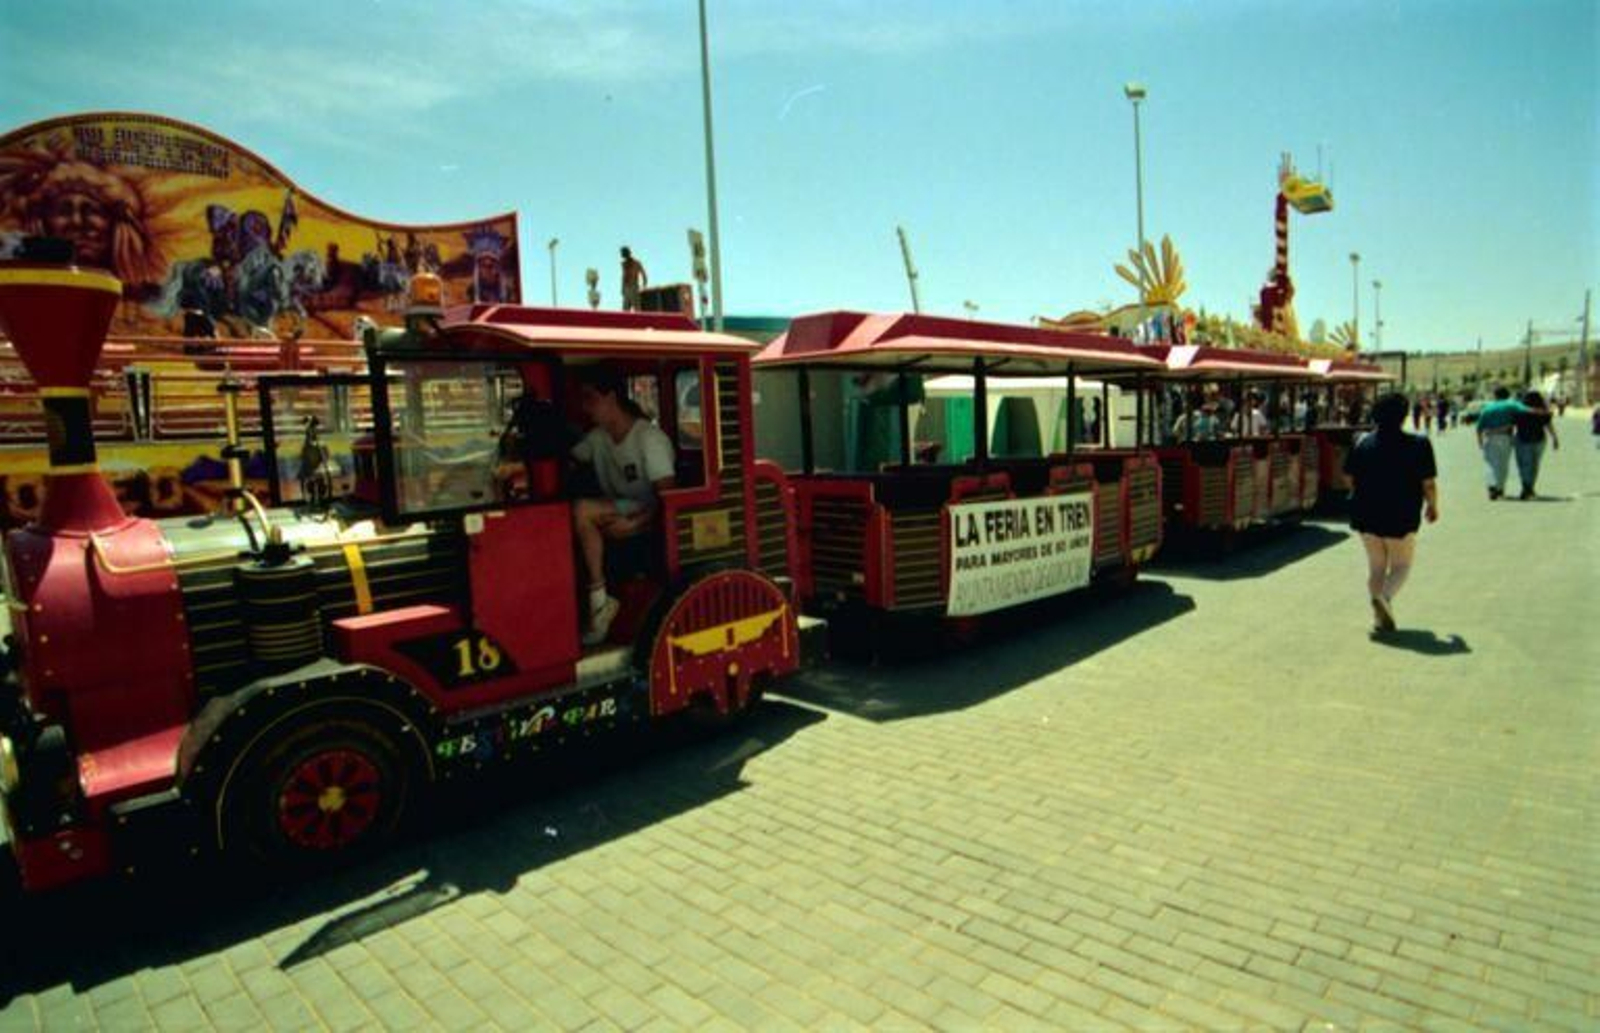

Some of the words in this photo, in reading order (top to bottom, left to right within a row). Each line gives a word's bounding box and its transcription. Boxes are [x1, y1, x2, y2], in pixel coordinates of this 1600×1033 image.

[955, 512, 980, 548] LA
[984, 507, 1030, 544] FERIA
[1035, 504, 1054, 536] EN
[1058, 501, 1089, 533] TREN
[956, 553, 987, 572] PARA
[991, 545, 1037, 567] MAYORES
[1040, 541, 1052, 558] DE
